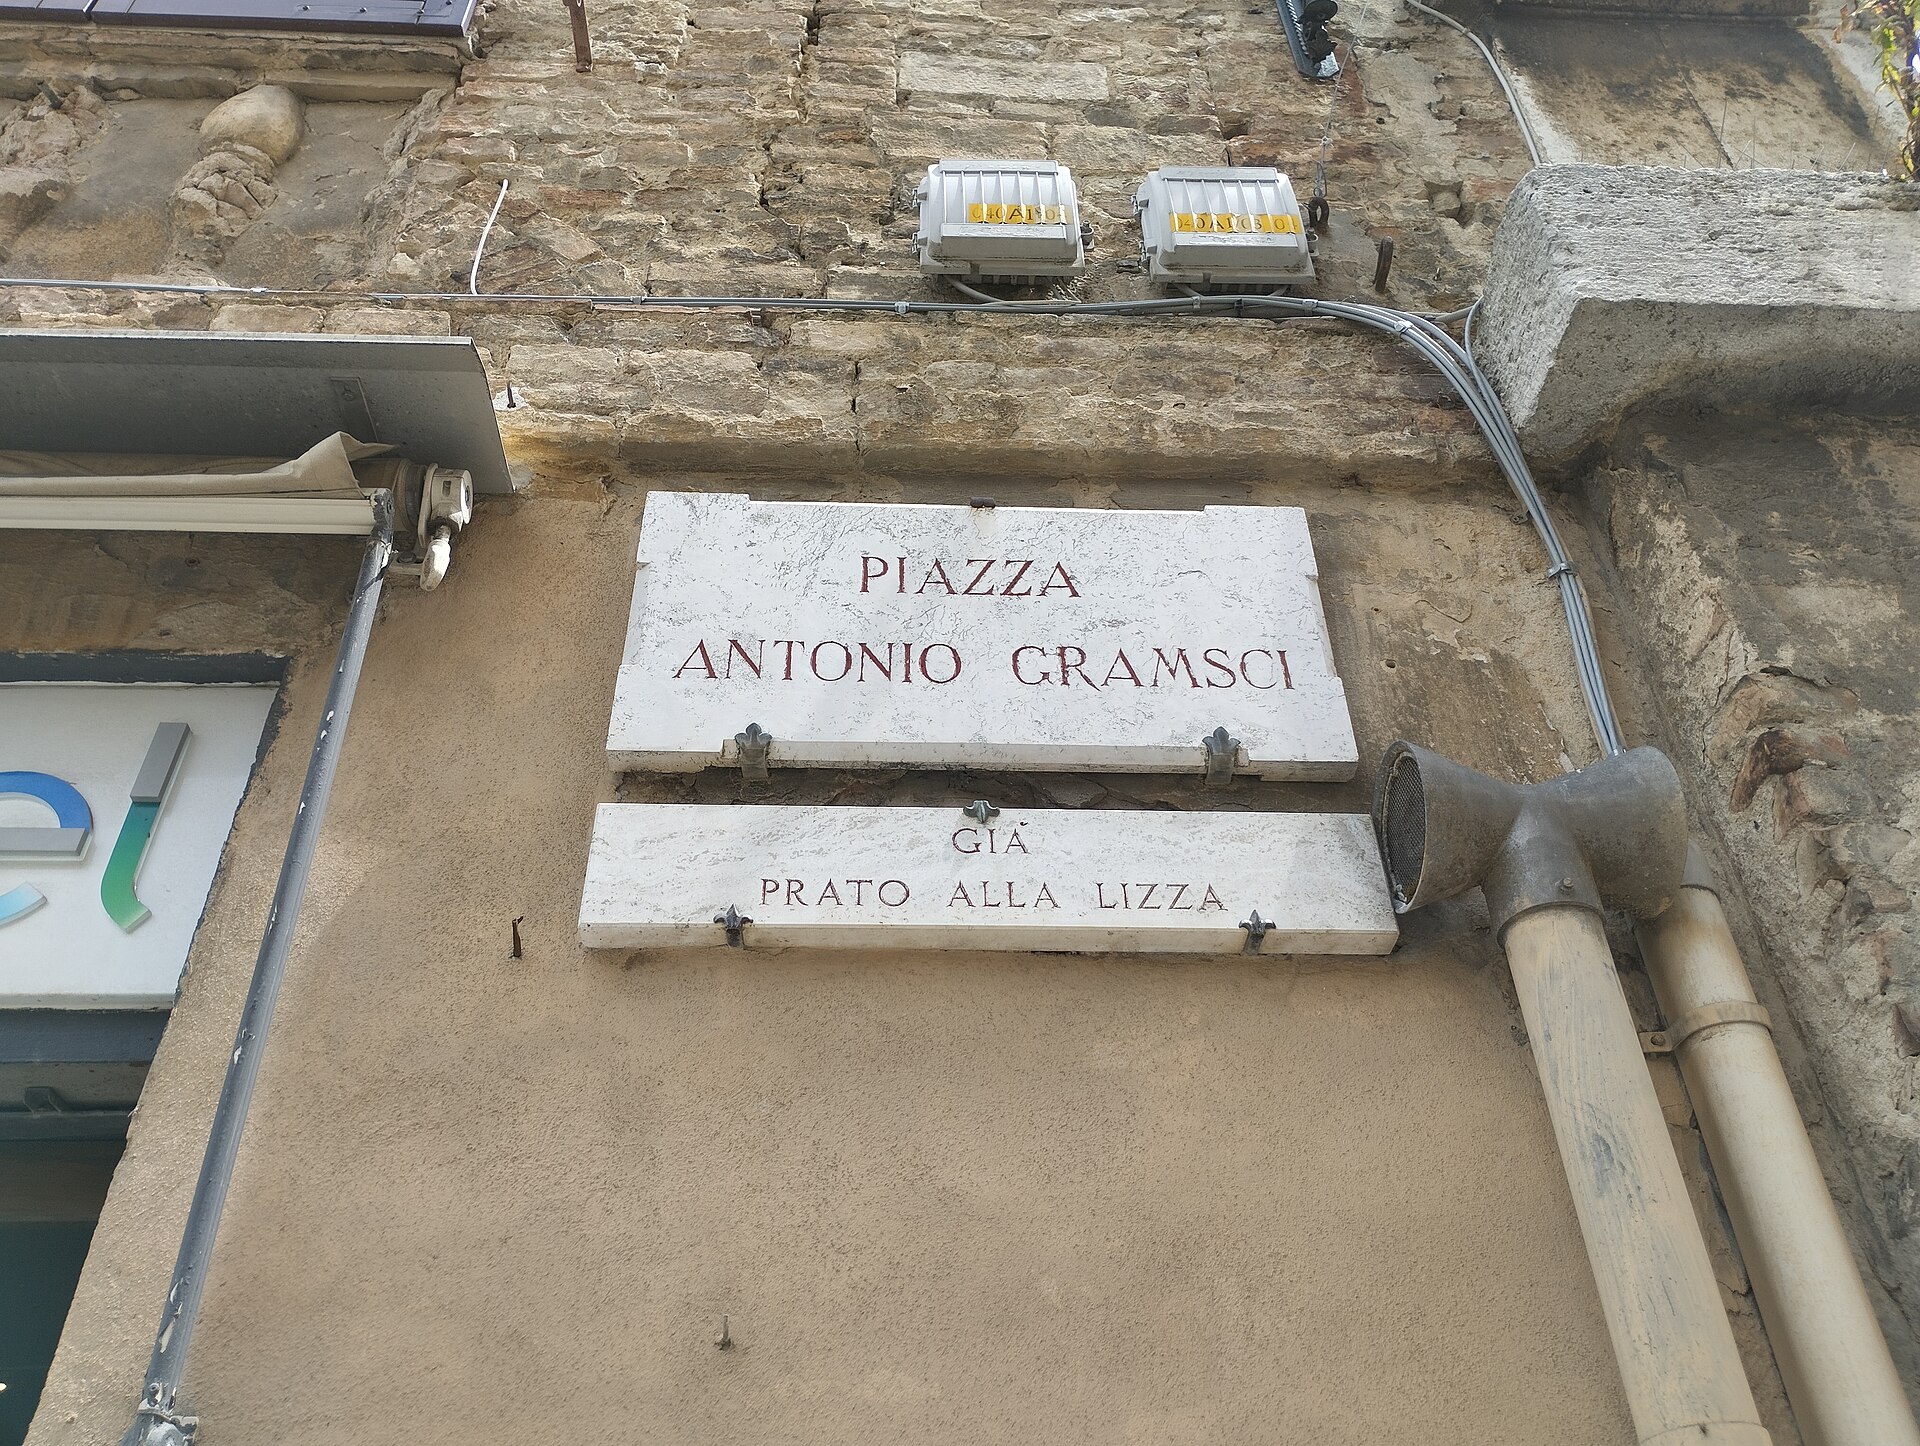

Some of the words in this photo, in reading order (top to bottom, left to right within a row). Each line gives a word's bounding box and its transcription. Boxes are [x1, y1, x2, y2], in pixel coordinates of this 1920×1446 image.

[860, 555, 1082, 598] PIAZZA
[672, 638, 963, 684] ANTONIO
[1011, 645, 1296, 692] GRAMSCI
[951, 821, 1032, 854] GIÀ
[759, 878, 911, 907] PRATO
[947, 880, 1061, 909] ALLA
[1097, 882, 1229, 912] LIZZA
